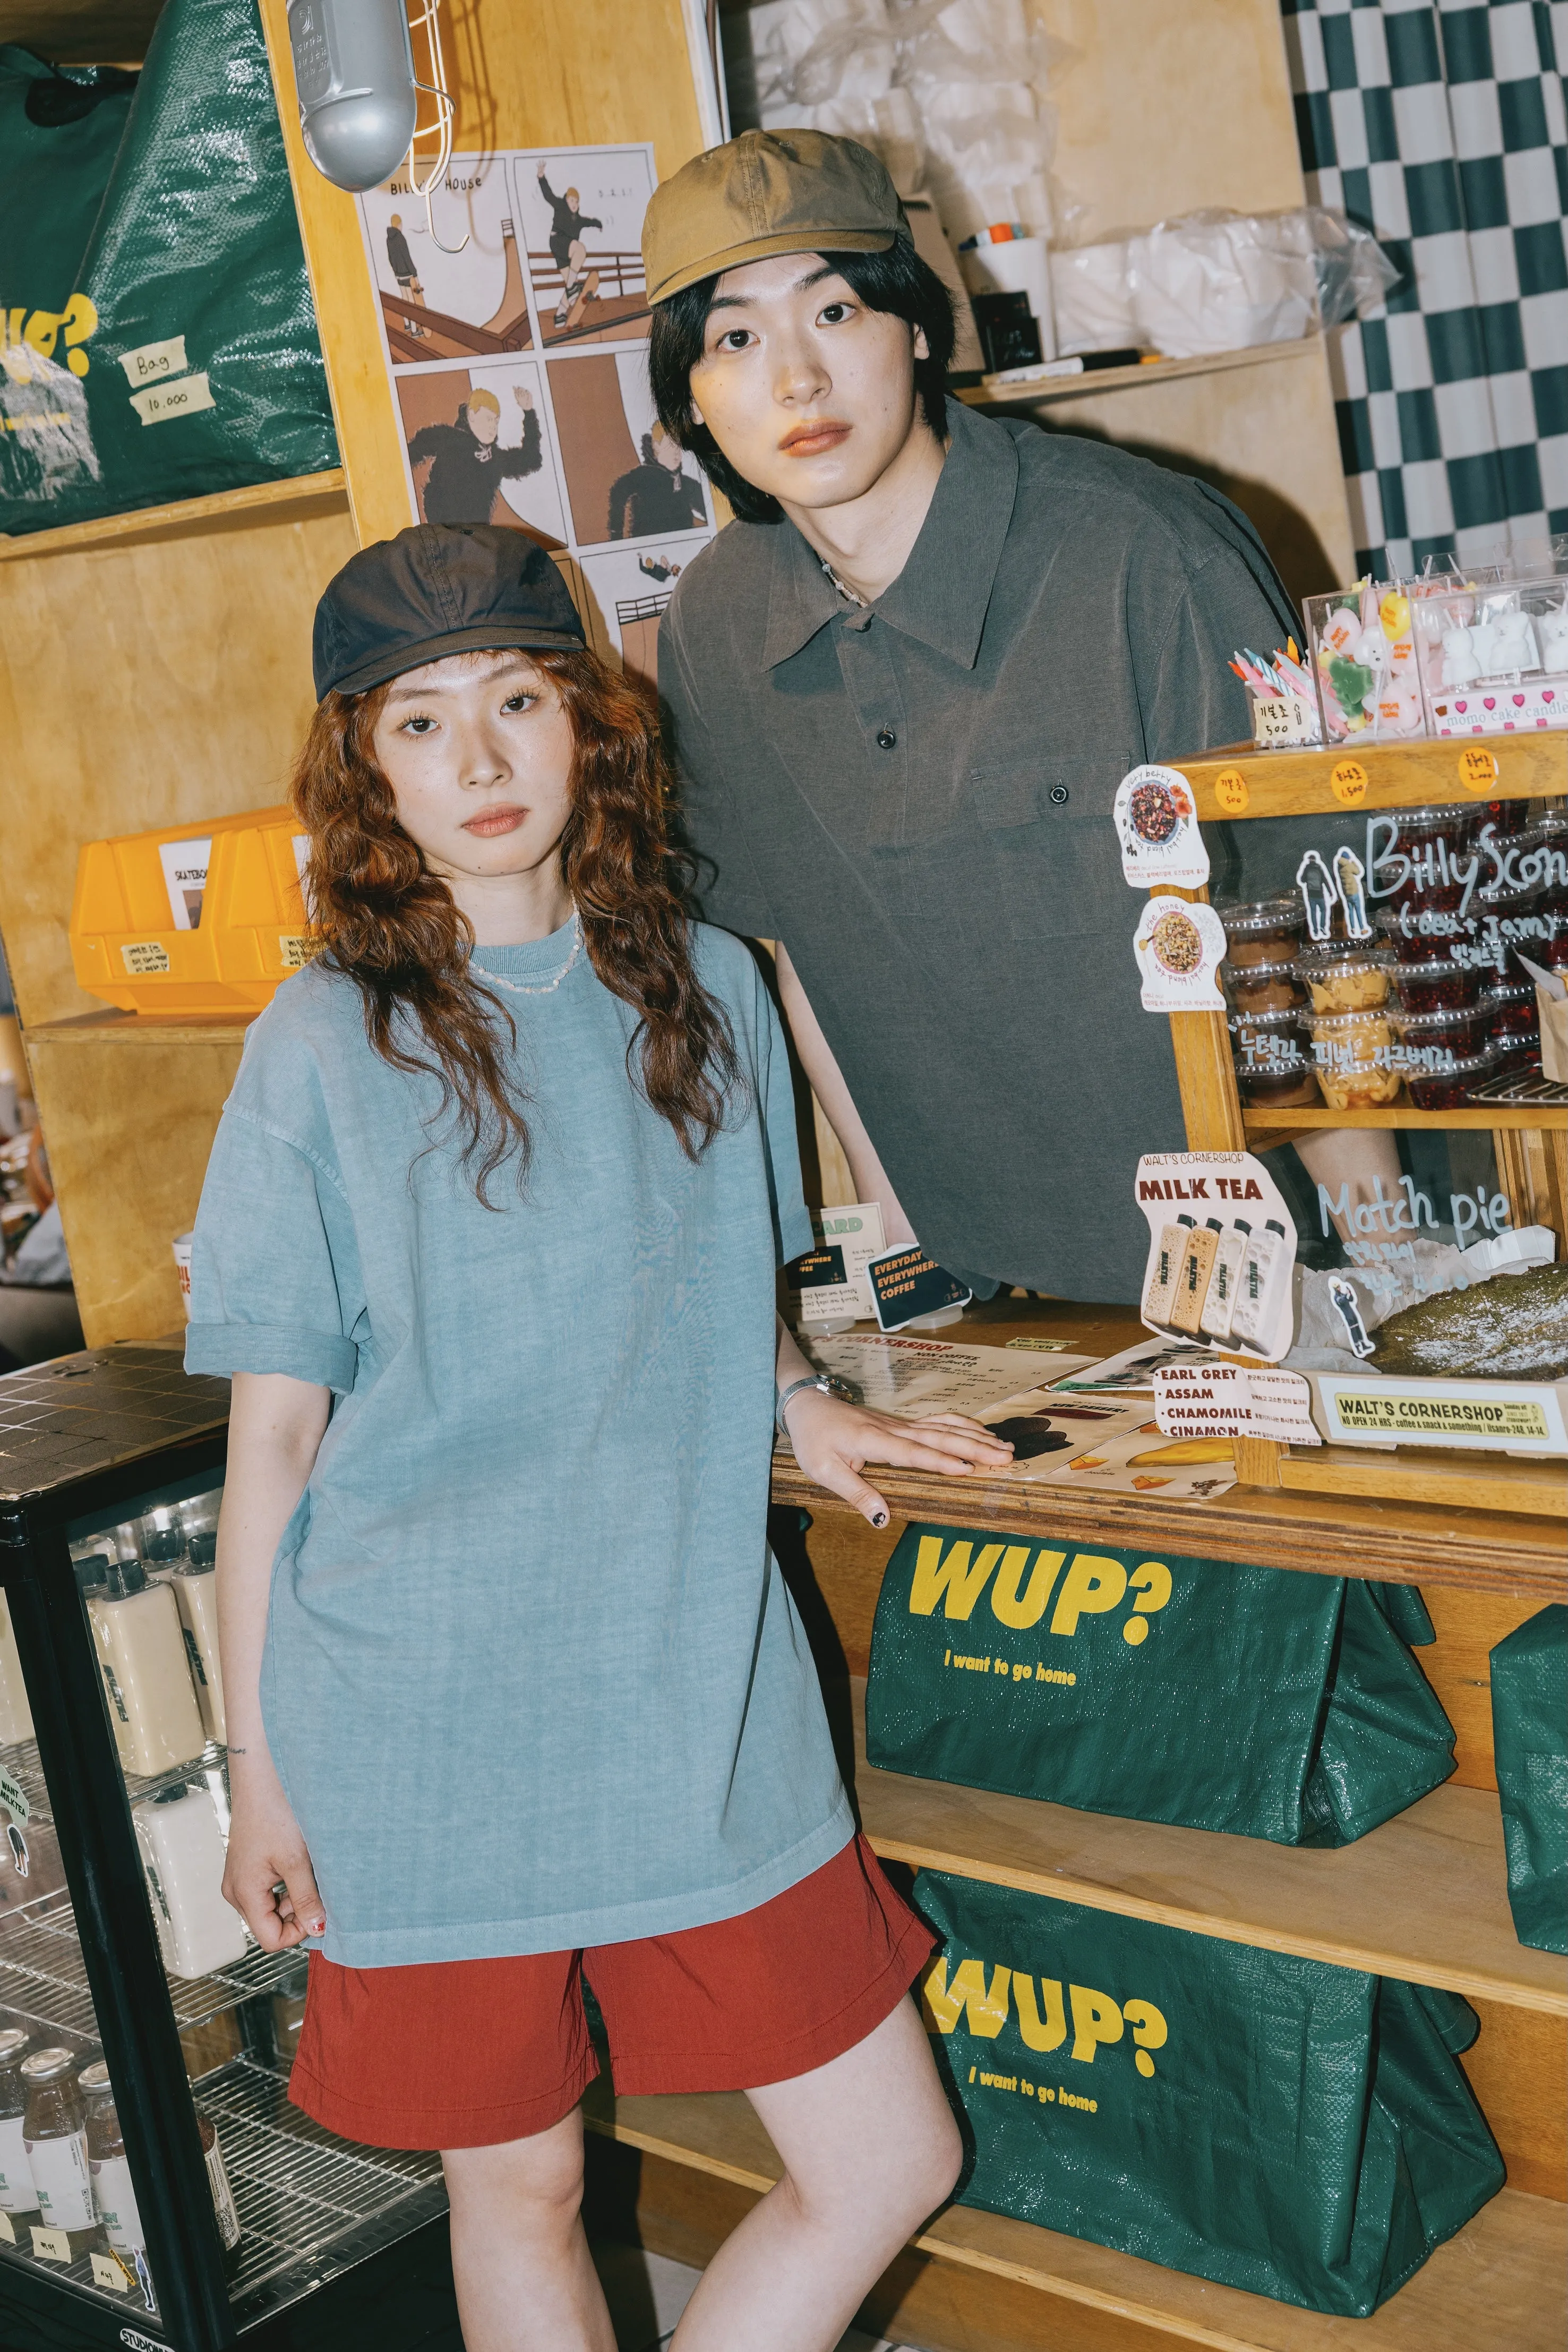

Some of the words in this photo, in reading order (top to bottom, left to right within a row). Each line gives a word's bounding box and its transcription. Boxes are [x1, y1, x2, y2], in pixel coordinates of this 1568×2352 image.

[137, 356, 170, 374] Bag
[148, 393, 188, 412] 10.000
[1446, 714, 1486, 728] momo
[1491, 707, 1521, 722] cake
[1266, 725, 1289, 736] 500
[1125, 772, 1143, 789] very
[1145, 767, 1171, 786] berry
[1226, 796, 1241, 804] 500
[1366, 816, 1479, 918] Billy
[1146, 914, 1158, 931] the
[1158, 903, 1185, 913] honey
[1241, 1029, 1303, 1067] 누텔라
[1310, 1039, 1355, 1074] 피넛
[1372, 1045, 1454, 1070] 라즈베리
[1143, 1153, 1179, 1166] WALT'S
[1180, 1152, 1244, 1165] CORNERSHOP
[1139, 1178, 1211, 1201] MILK
[1215, 1178, 1264, 1200] TEA
[1450, 1185, 1513, 1251] pie
[874, 1250, 923, 1276] EVERYDAY
[880, 1280, 916, 1301] COFFEE
[836, 1336, 954, 1352] CORNERSHOP
[1161, 1369, 1197, 1380] EARL
[1202, 1369, 1237, 1380] GREY
[1165, 1388, 1214, 1399] ASSAM
[1078, 1405, 1130, 1414] DESSERT
[1167, 1408, 1252, 1419] CHAMOMILE
[1339, 1399, 1395, 1416] WALT'S
[1399, 1402, 1503, 1422] CORNERSHOP
[1169, 1426, 1239, 1437] CINAMON
[1342, 1415, 1350, 1425] NO
[1352, 1416, 1368, 1426] OPEN
[1369, 1417, 1377, 1427] 24
[1379, 1418, 1392, 1427] HRS
[1395, 1419, 1416, 1429] coffee
[1423, 1420, 1442, 1430] snack
[1449, 1422, 1483, 1433] something
[909, 1535, 1172, 1646] WUP?
[945, 1649, 951, 1666] I
[954, 1654, 990, 1673] want
[994, 1657, 1009, 1675] to
[1012, 1664, 1032, 1682] go
[1036, 1662, 1077, 1687] home
[2, 1780, 19, 1799] WANT
[0, 1789, 26, 1818] MILKTEA
[921, 1956, 1168, 2078] WUP?
[968, 2066, 976, 2084] I
[980, 2071, 1017, 2093] want
[1020, 2077, 1035, 2097] to
[1037, 2085, 1055, 2104] go
[1058, 2086, 1098, 2114] home
[110, 2249, 124, 2269] STUDIO
